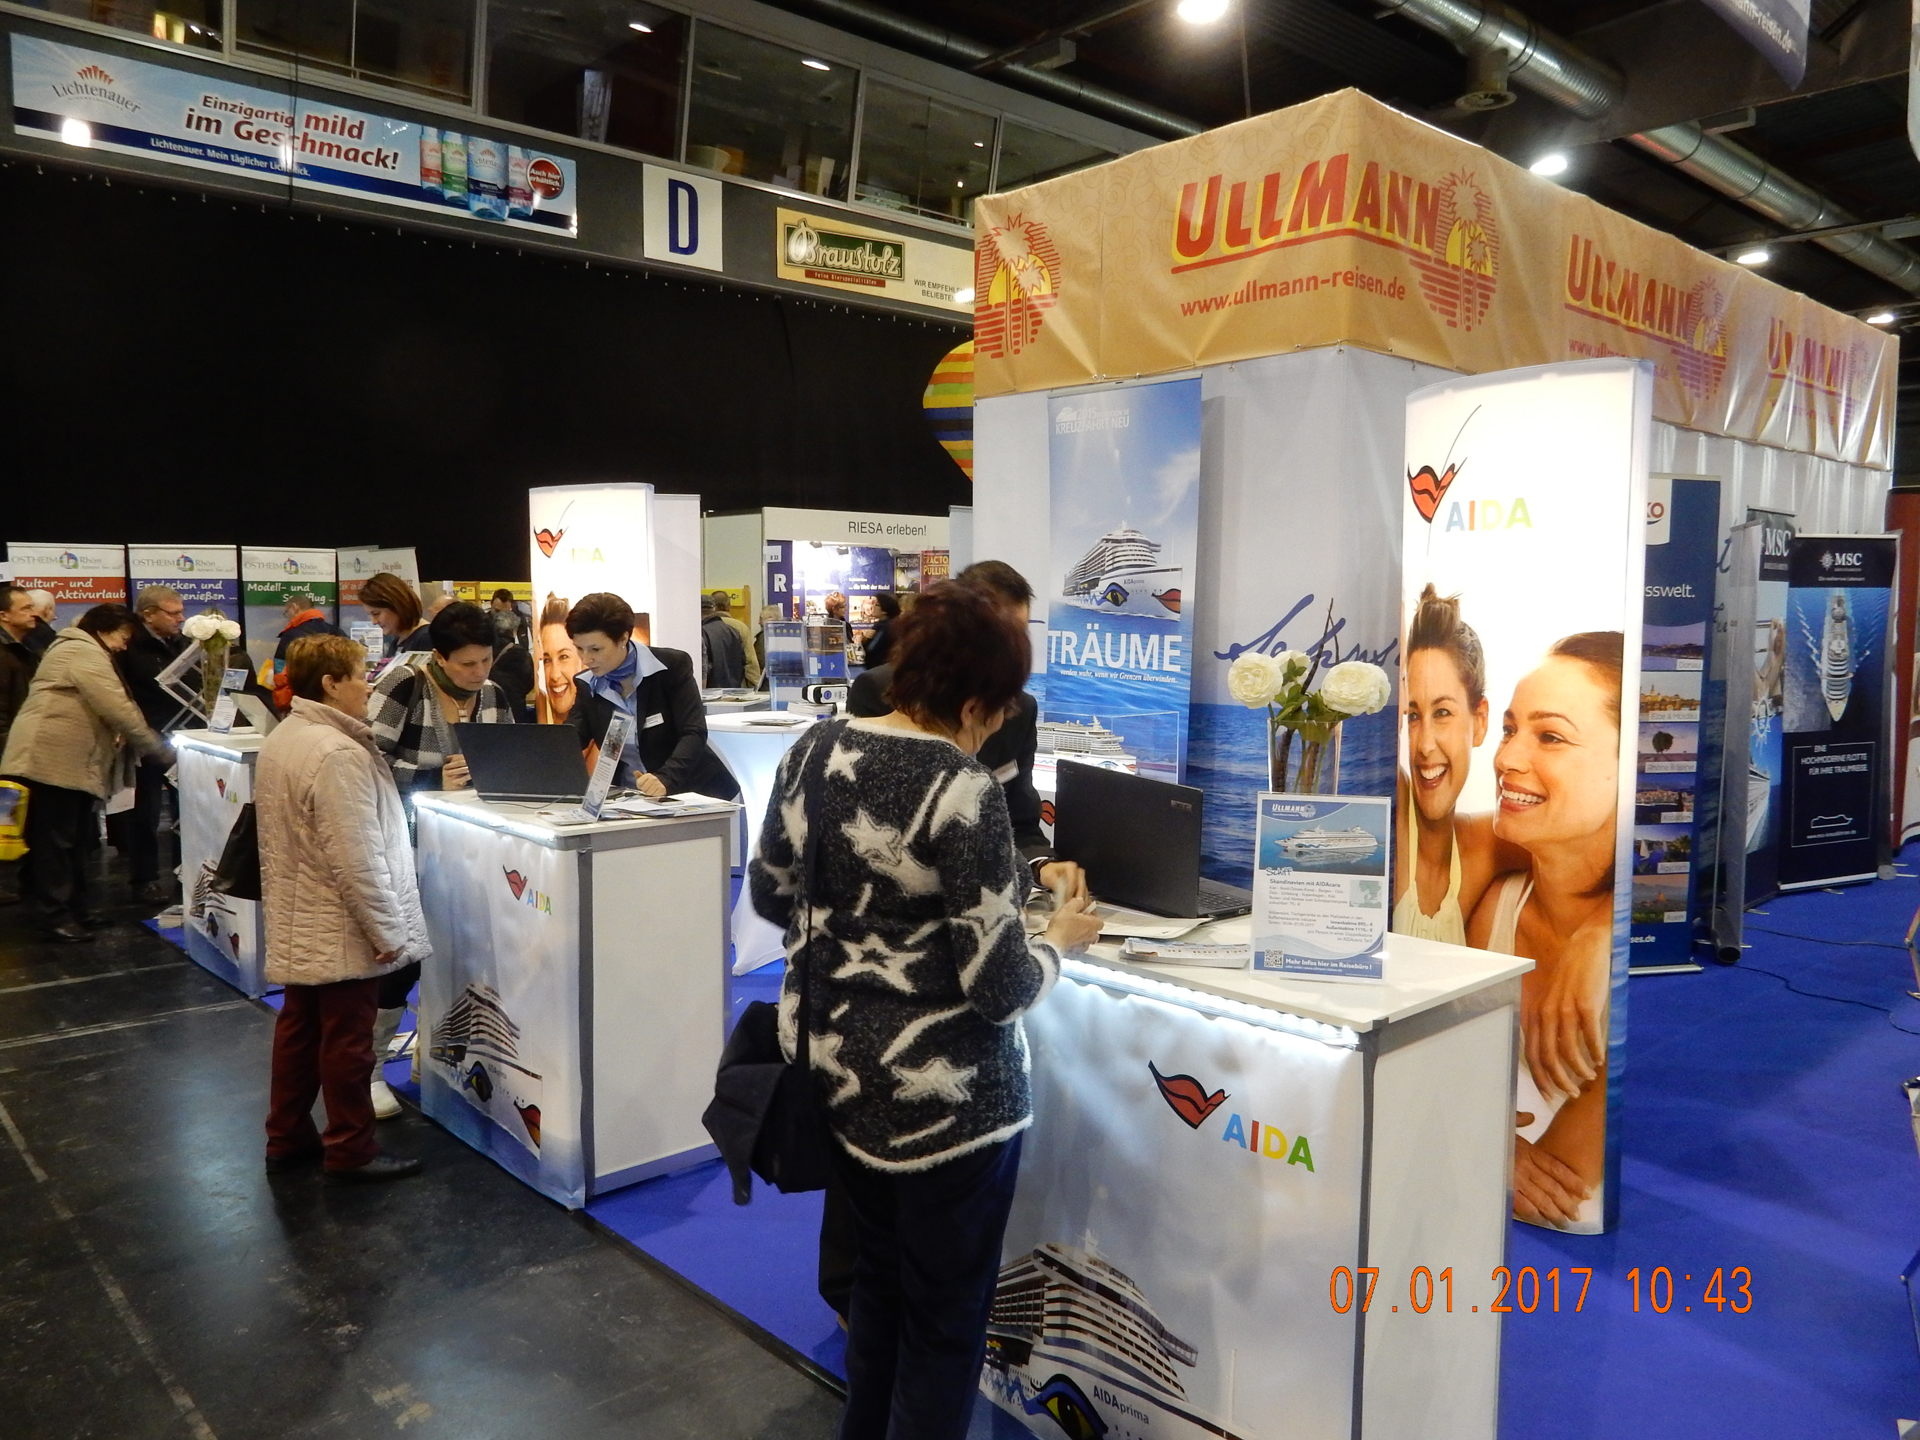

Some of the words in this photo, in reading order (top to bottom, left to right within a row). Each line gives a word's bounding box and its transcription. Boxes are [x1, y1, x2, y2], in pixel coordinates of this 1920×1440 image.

[51, 80, 141, 114] Lichtenauer
[202, 95, 296, 128] Einzigartig
[304, 112, 366, 140] mild
[185, 108, 223, 135] im
[233, 119, 400, 171] Geschmack!
[206, 148, 230, 162] Mein
[230, 151, 268, 169] täglicher
[667, 177, 699, 256] D
[1171, 153, 1442, 264] ULLMANN
[786, 219, 903, 279] Braustolz
[913, 278, 927, 288] WIR
[1179, 263, 1407, 318] www.ullmann-reisen.de
[1565, 233, 1694, 346] ULLMANN
[1111, 416, 1130, 429] NEU
[1445, 497, 1534, 533] AIDA
[848, 521, 884, 535] RIESA
[886, 524, 928, 537] erleben!
[1764, 528, 1792, 558] MSC
[12, 556, 60, 564] OSTHEIM
[79, 556, 102, 565] Rhön
[132, 559, 177, 567] OSTHEIM
[195, 559, 216, 567] Rhön
[299, 562, 318, 570] Rhön
[1834, 552, 1863, 567] MSC
[16, 578, 65, 589] Kultur-
[69, 578, 93, 588] und
[200, 580, 223, 590] und
[247, 582, 287, 592] Modell-
[290, 583, 311, 592] und
[56, 589, 127, 600] Aktivurlaub
[178, 591, 226, 603] enießen
[1047, 622, 1183, 672] TRÄUME
[1078, 670, 1094, 678] wahr,
[1109, 671, 1119, 679] wir
[1119, 672, 1143, 681] Grenzen
[1271, 803, 1305, 813] ULLMANN
[1265, 866, 1294, 877] Schiff
[526, 888, 552, 916] AIDA
[1339, 962, 1369, 970] Reisebüro
[1222, 1112, 1315, 1174] AIDA
[1092, 1384, 1150, 1425] AIDAprima
